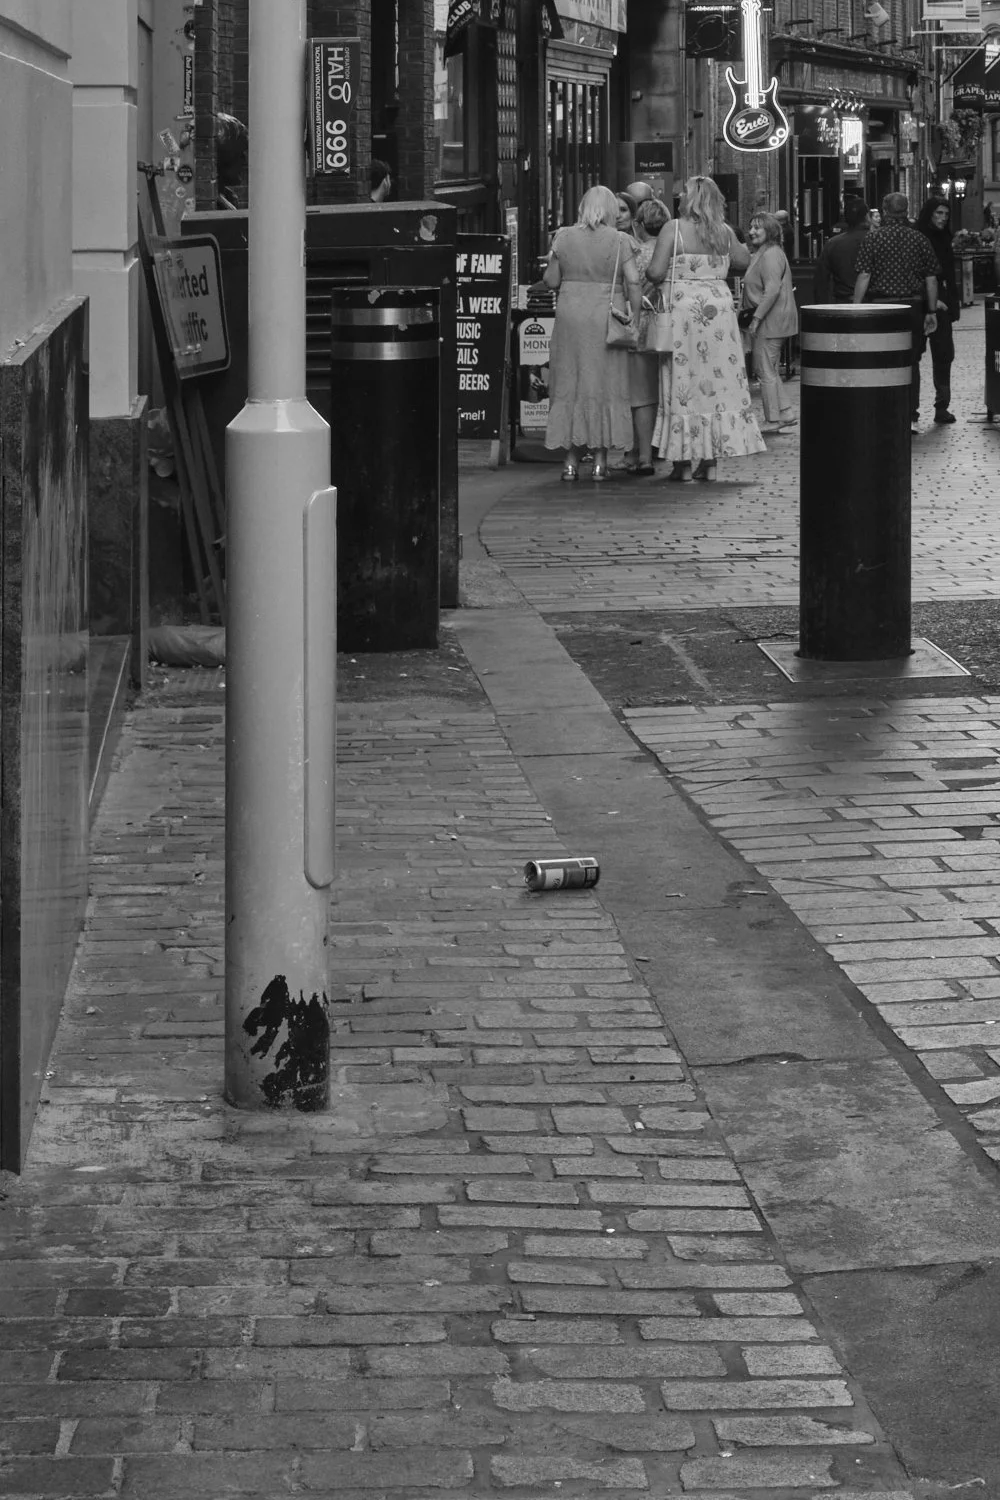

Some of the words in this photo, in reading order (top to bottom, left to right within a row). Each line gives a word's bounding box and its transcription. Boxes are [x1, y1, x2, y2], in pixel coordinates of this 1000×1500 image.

[447, 1, 471, 27] CLUB
[327, 47, 344, 100] HALO
[735, 114, 769, 138] Eric's
[325, 119, 347, 167] 999
[470, 253, 502, 273] FAME
[469, 297, 502, 314] WEEK
[459, 373, 490, 390] BEERS
